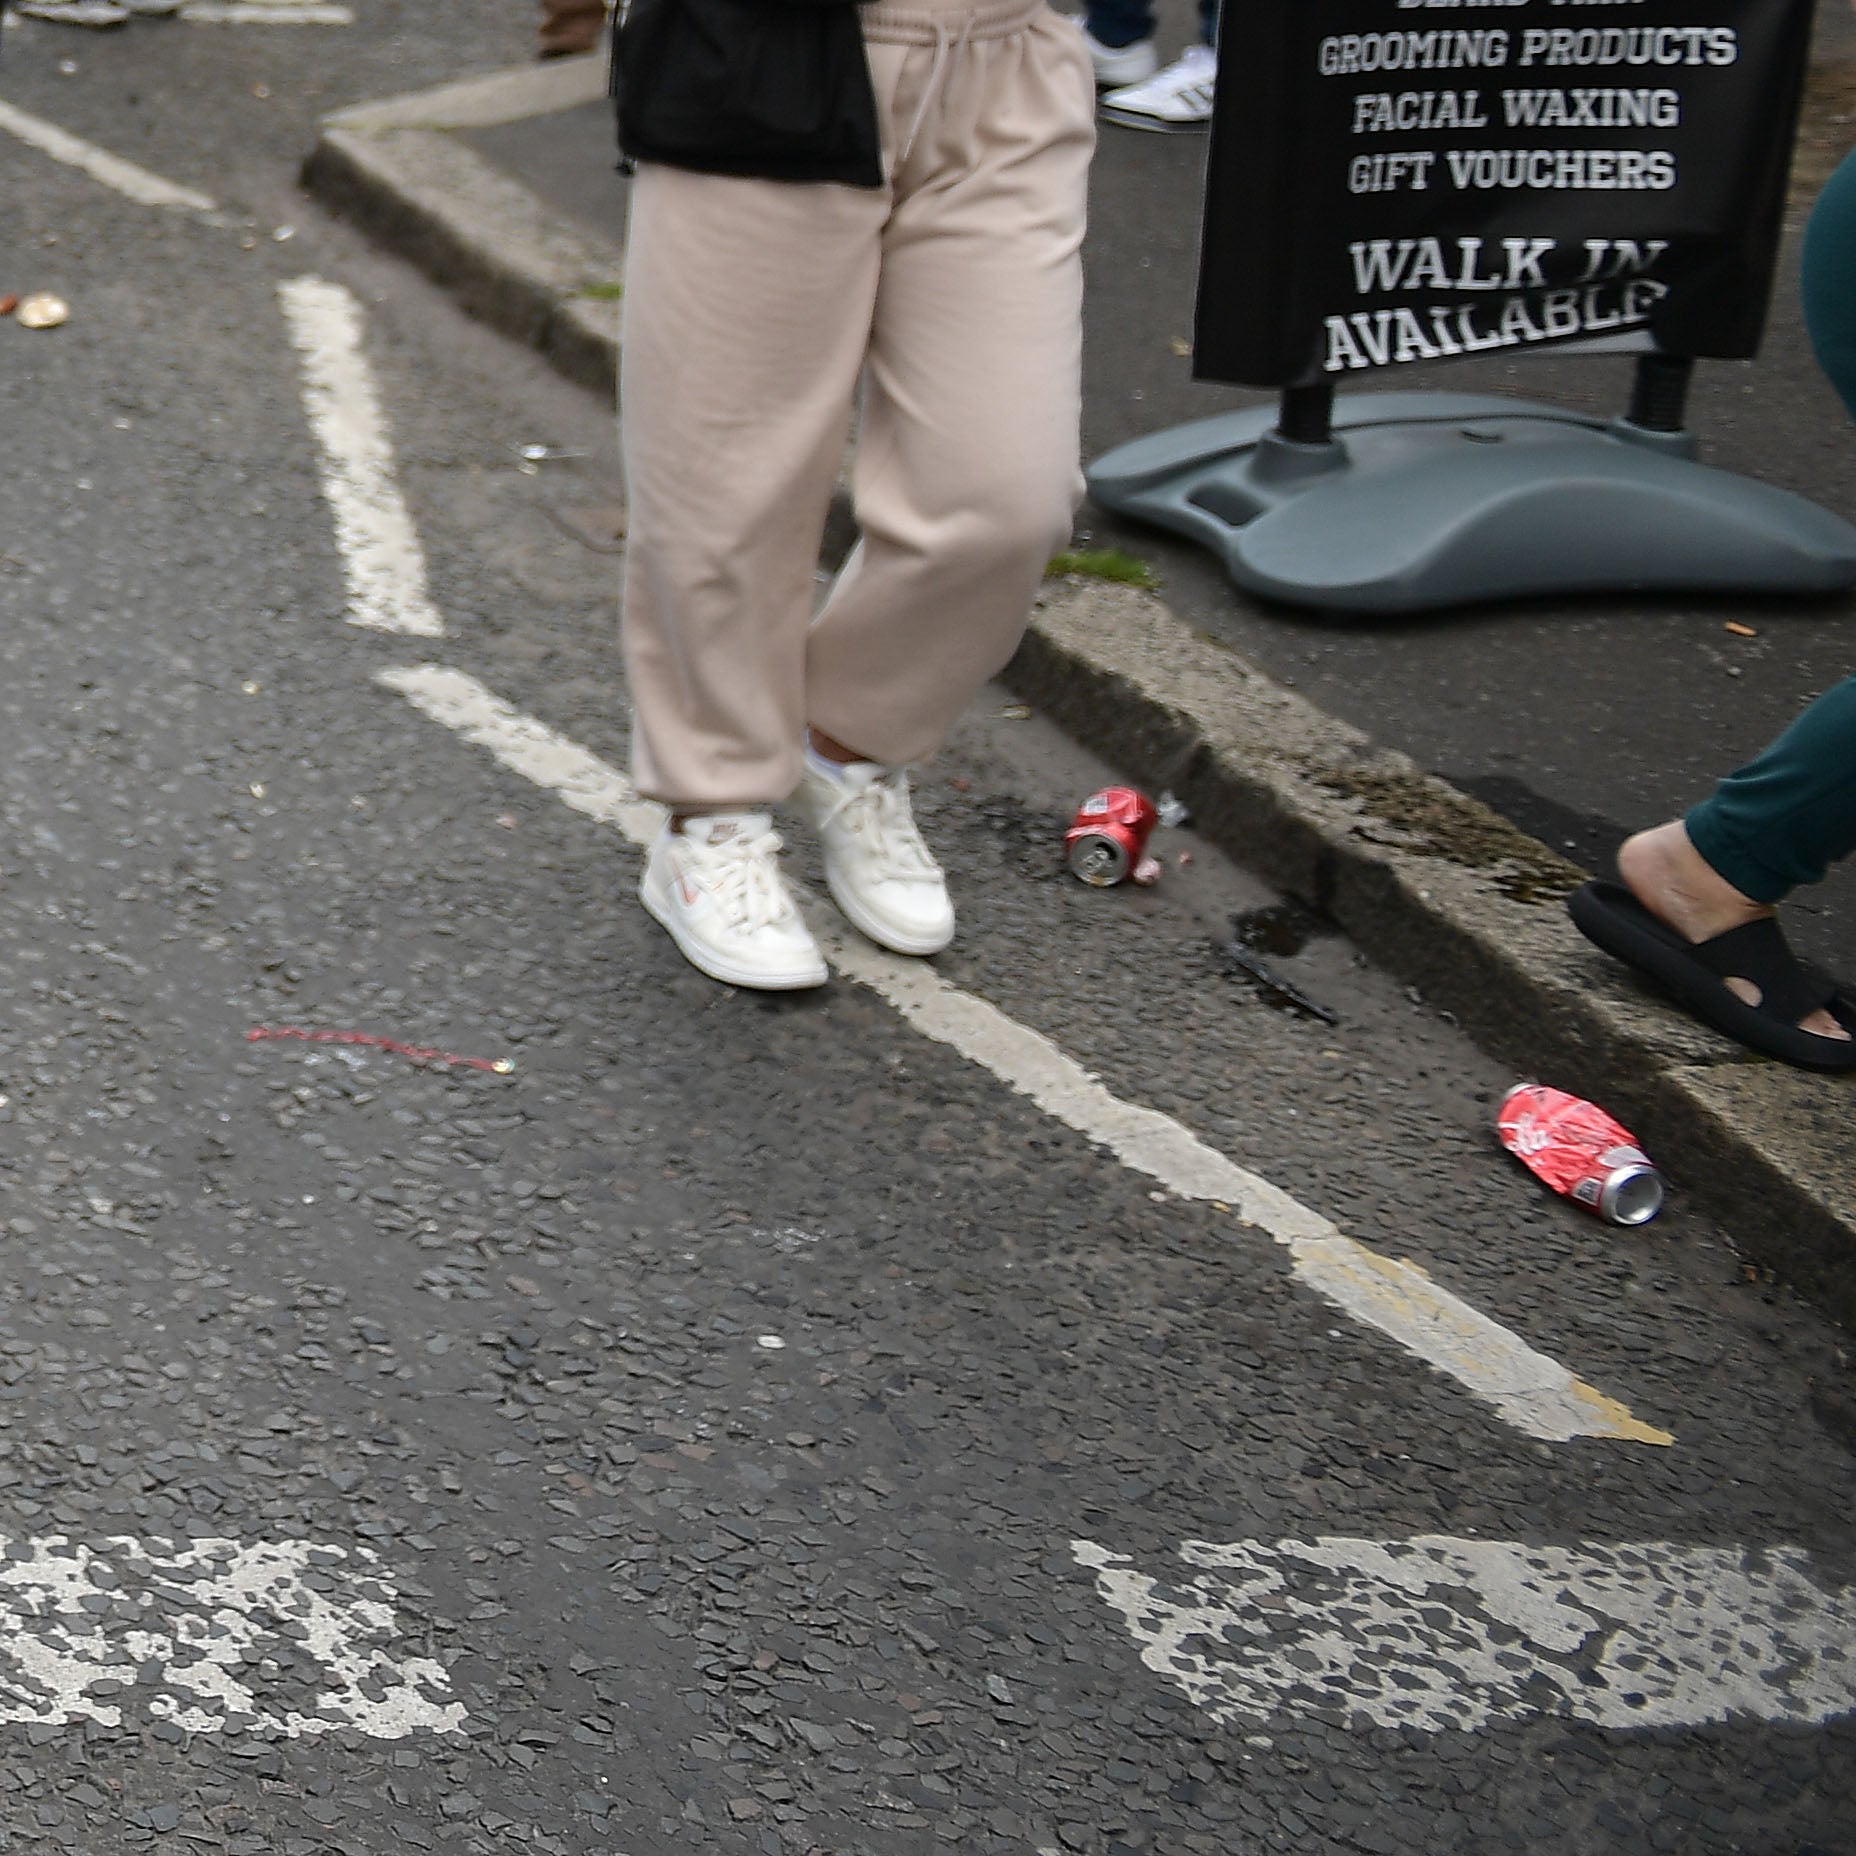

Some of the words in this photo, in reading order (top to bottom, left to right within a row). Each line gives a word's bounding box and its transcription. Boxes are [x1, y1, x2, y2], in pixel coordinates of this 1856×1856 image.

[1318, 29, 1509, 76] GROOMING
[1517, 26, 1738, 66] PRODUCTS
[1351, 89, 1488, 133] FACIAL
[1501, 89, 1680, 127] WAXING
[1347, 151, 1434, 194] GIFT
[1446, 150, 1677, 190] VOUCHERS
[1348, 236, 1556, 294] WALK
